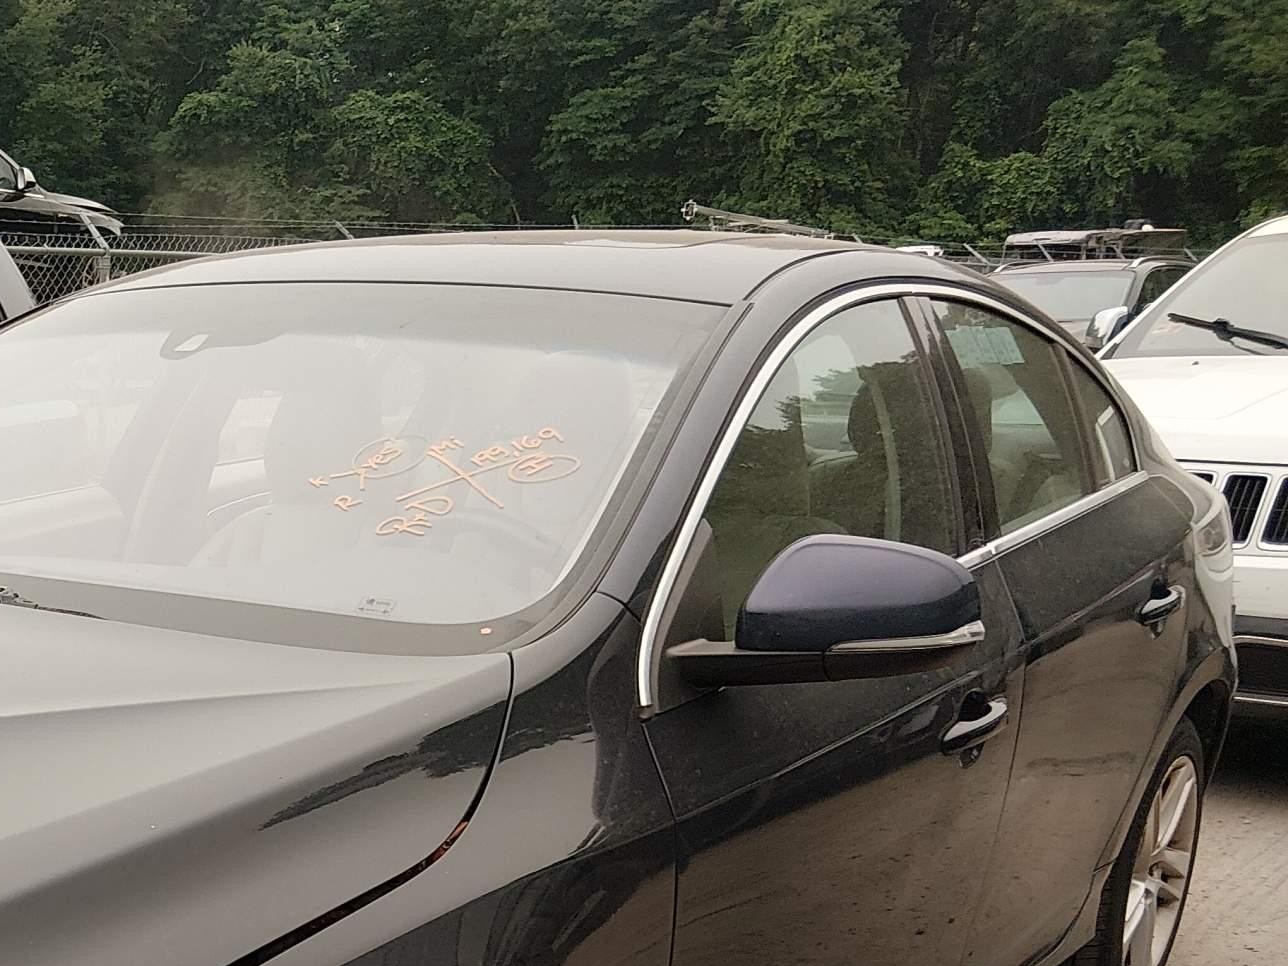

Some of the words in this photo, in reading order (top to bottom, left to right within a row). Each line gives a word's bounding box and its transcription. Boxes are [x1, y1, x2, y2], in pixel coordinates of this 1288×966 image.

[428, 436, 465, 456] Mi
[470, 426, 565, 466] 199,169
[333, 495, 364, 512] R
